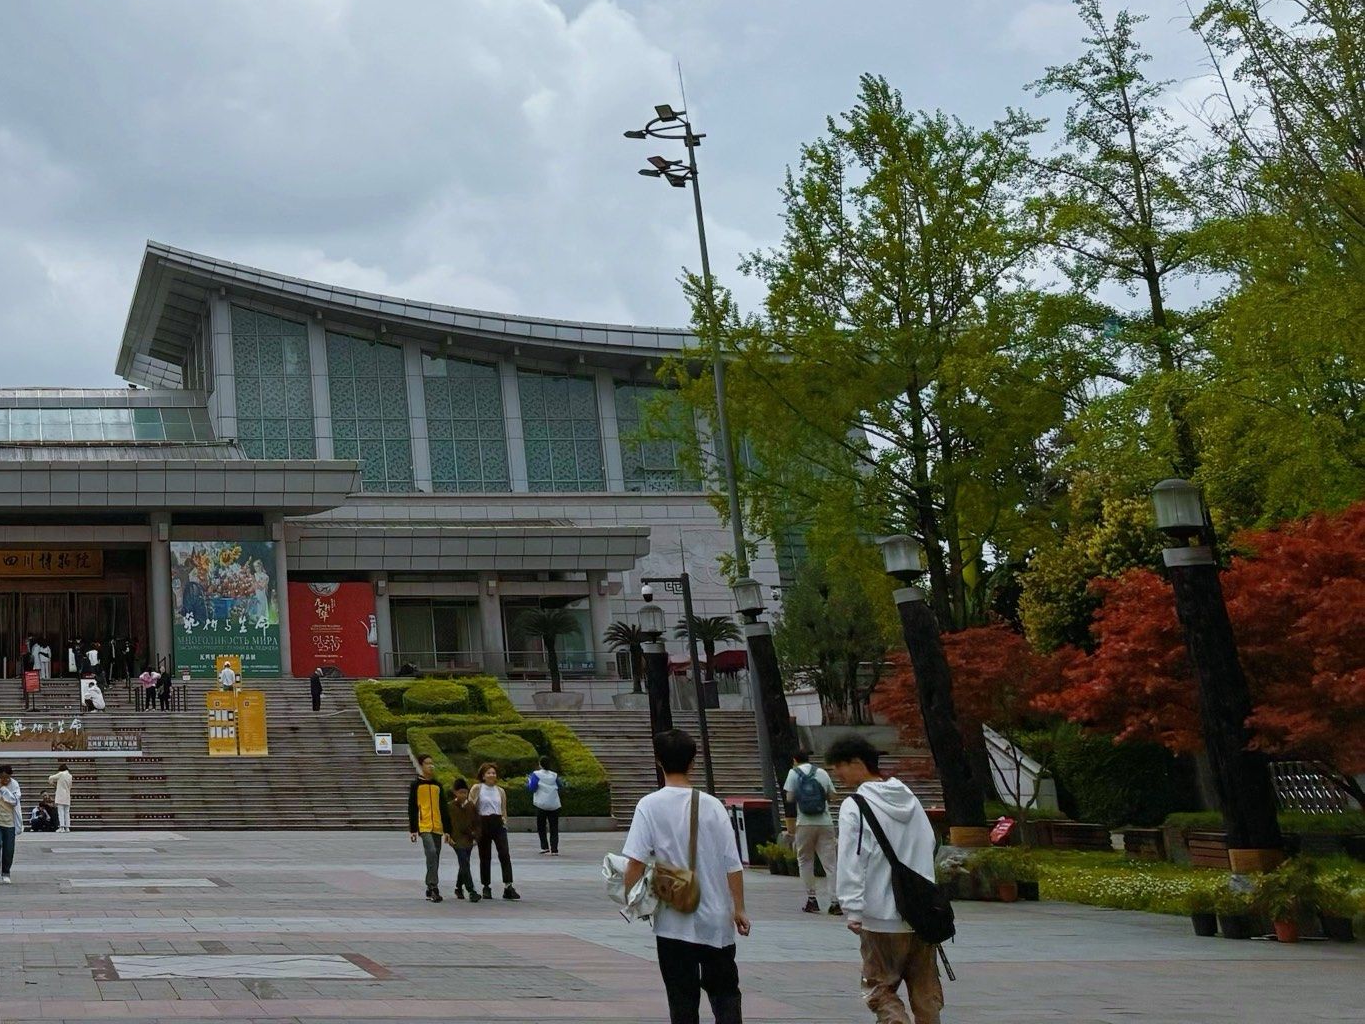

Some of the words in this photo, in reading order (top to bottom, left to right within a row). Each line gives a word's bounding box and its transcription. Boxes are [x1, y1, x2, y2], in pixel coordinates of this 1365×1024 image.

[3, 552, 91, 570] 四川博物院
